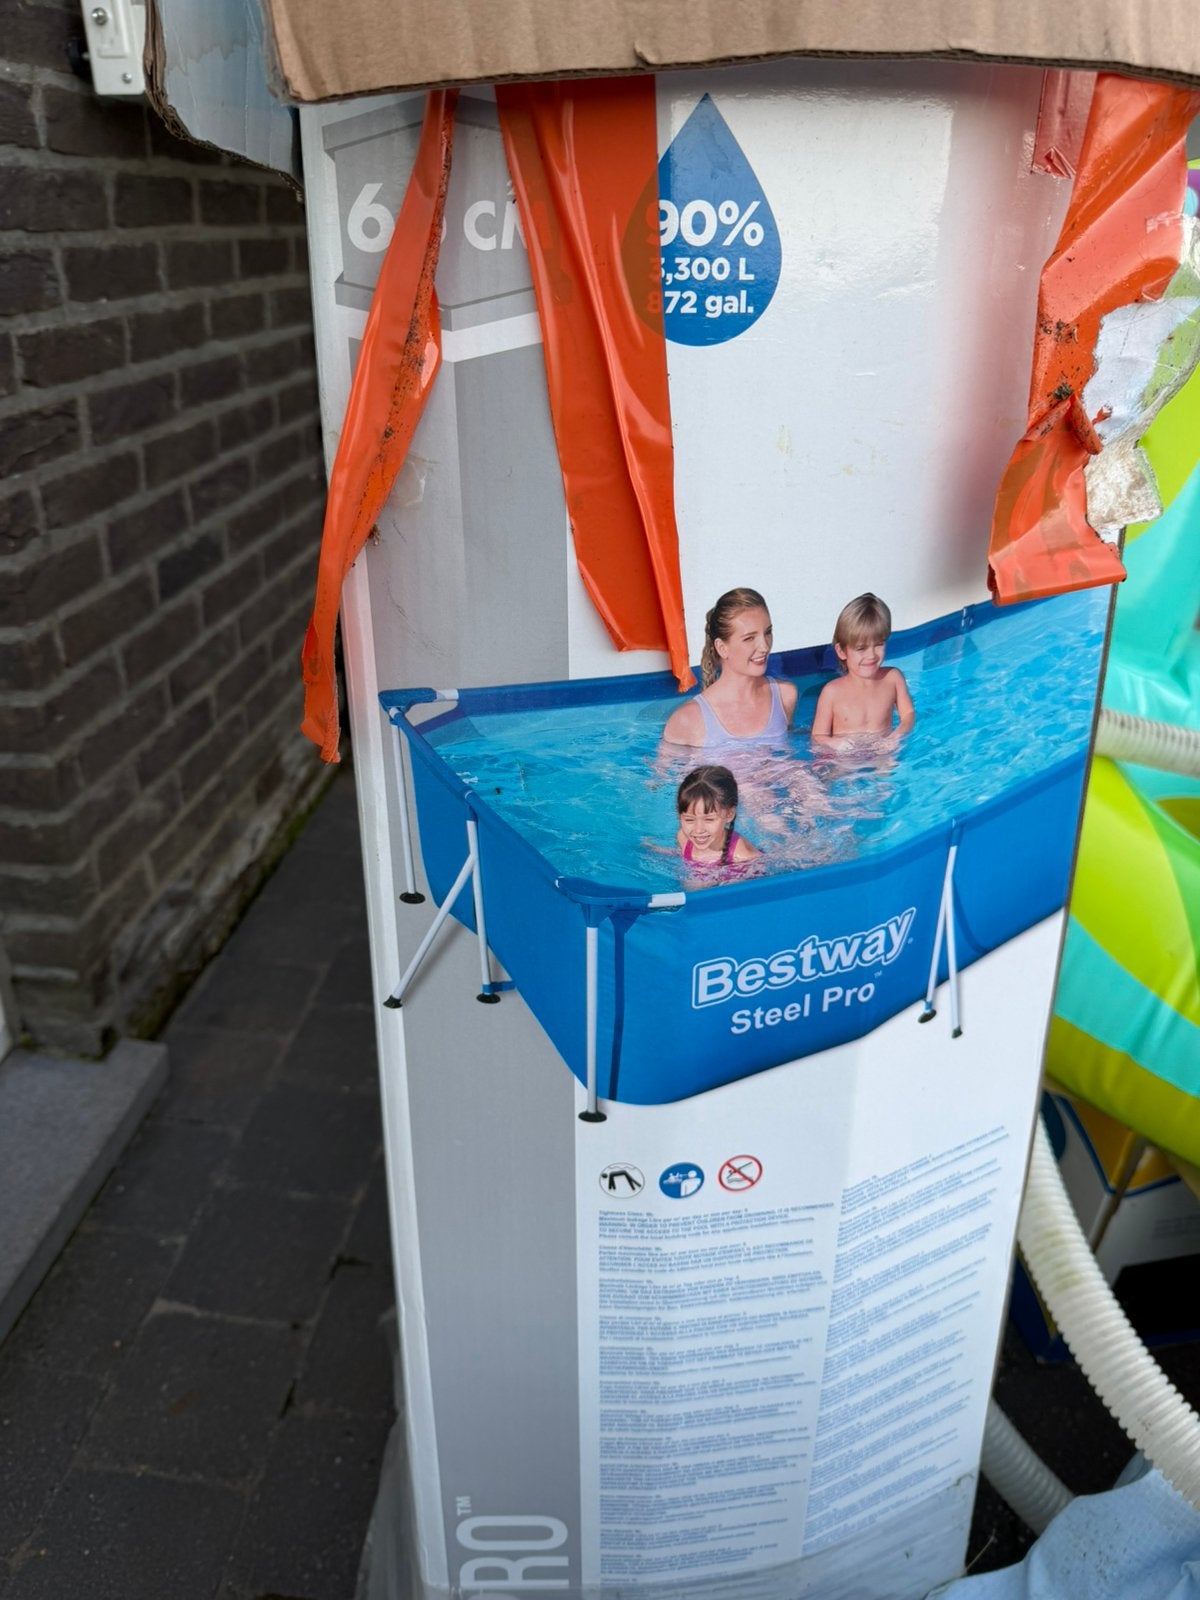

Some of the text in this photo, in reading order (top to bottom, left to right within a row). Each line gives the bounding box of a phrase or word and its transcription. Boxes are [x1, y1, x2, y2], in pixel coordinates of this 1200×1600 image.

[645, 199, 764, 247] 90%
[738, 257, 755, 280] L
[704, 289, 754, 318] gal.
[692, 906, 916, 1009] Bestway
[730, 993, 811, 1035] Steel
